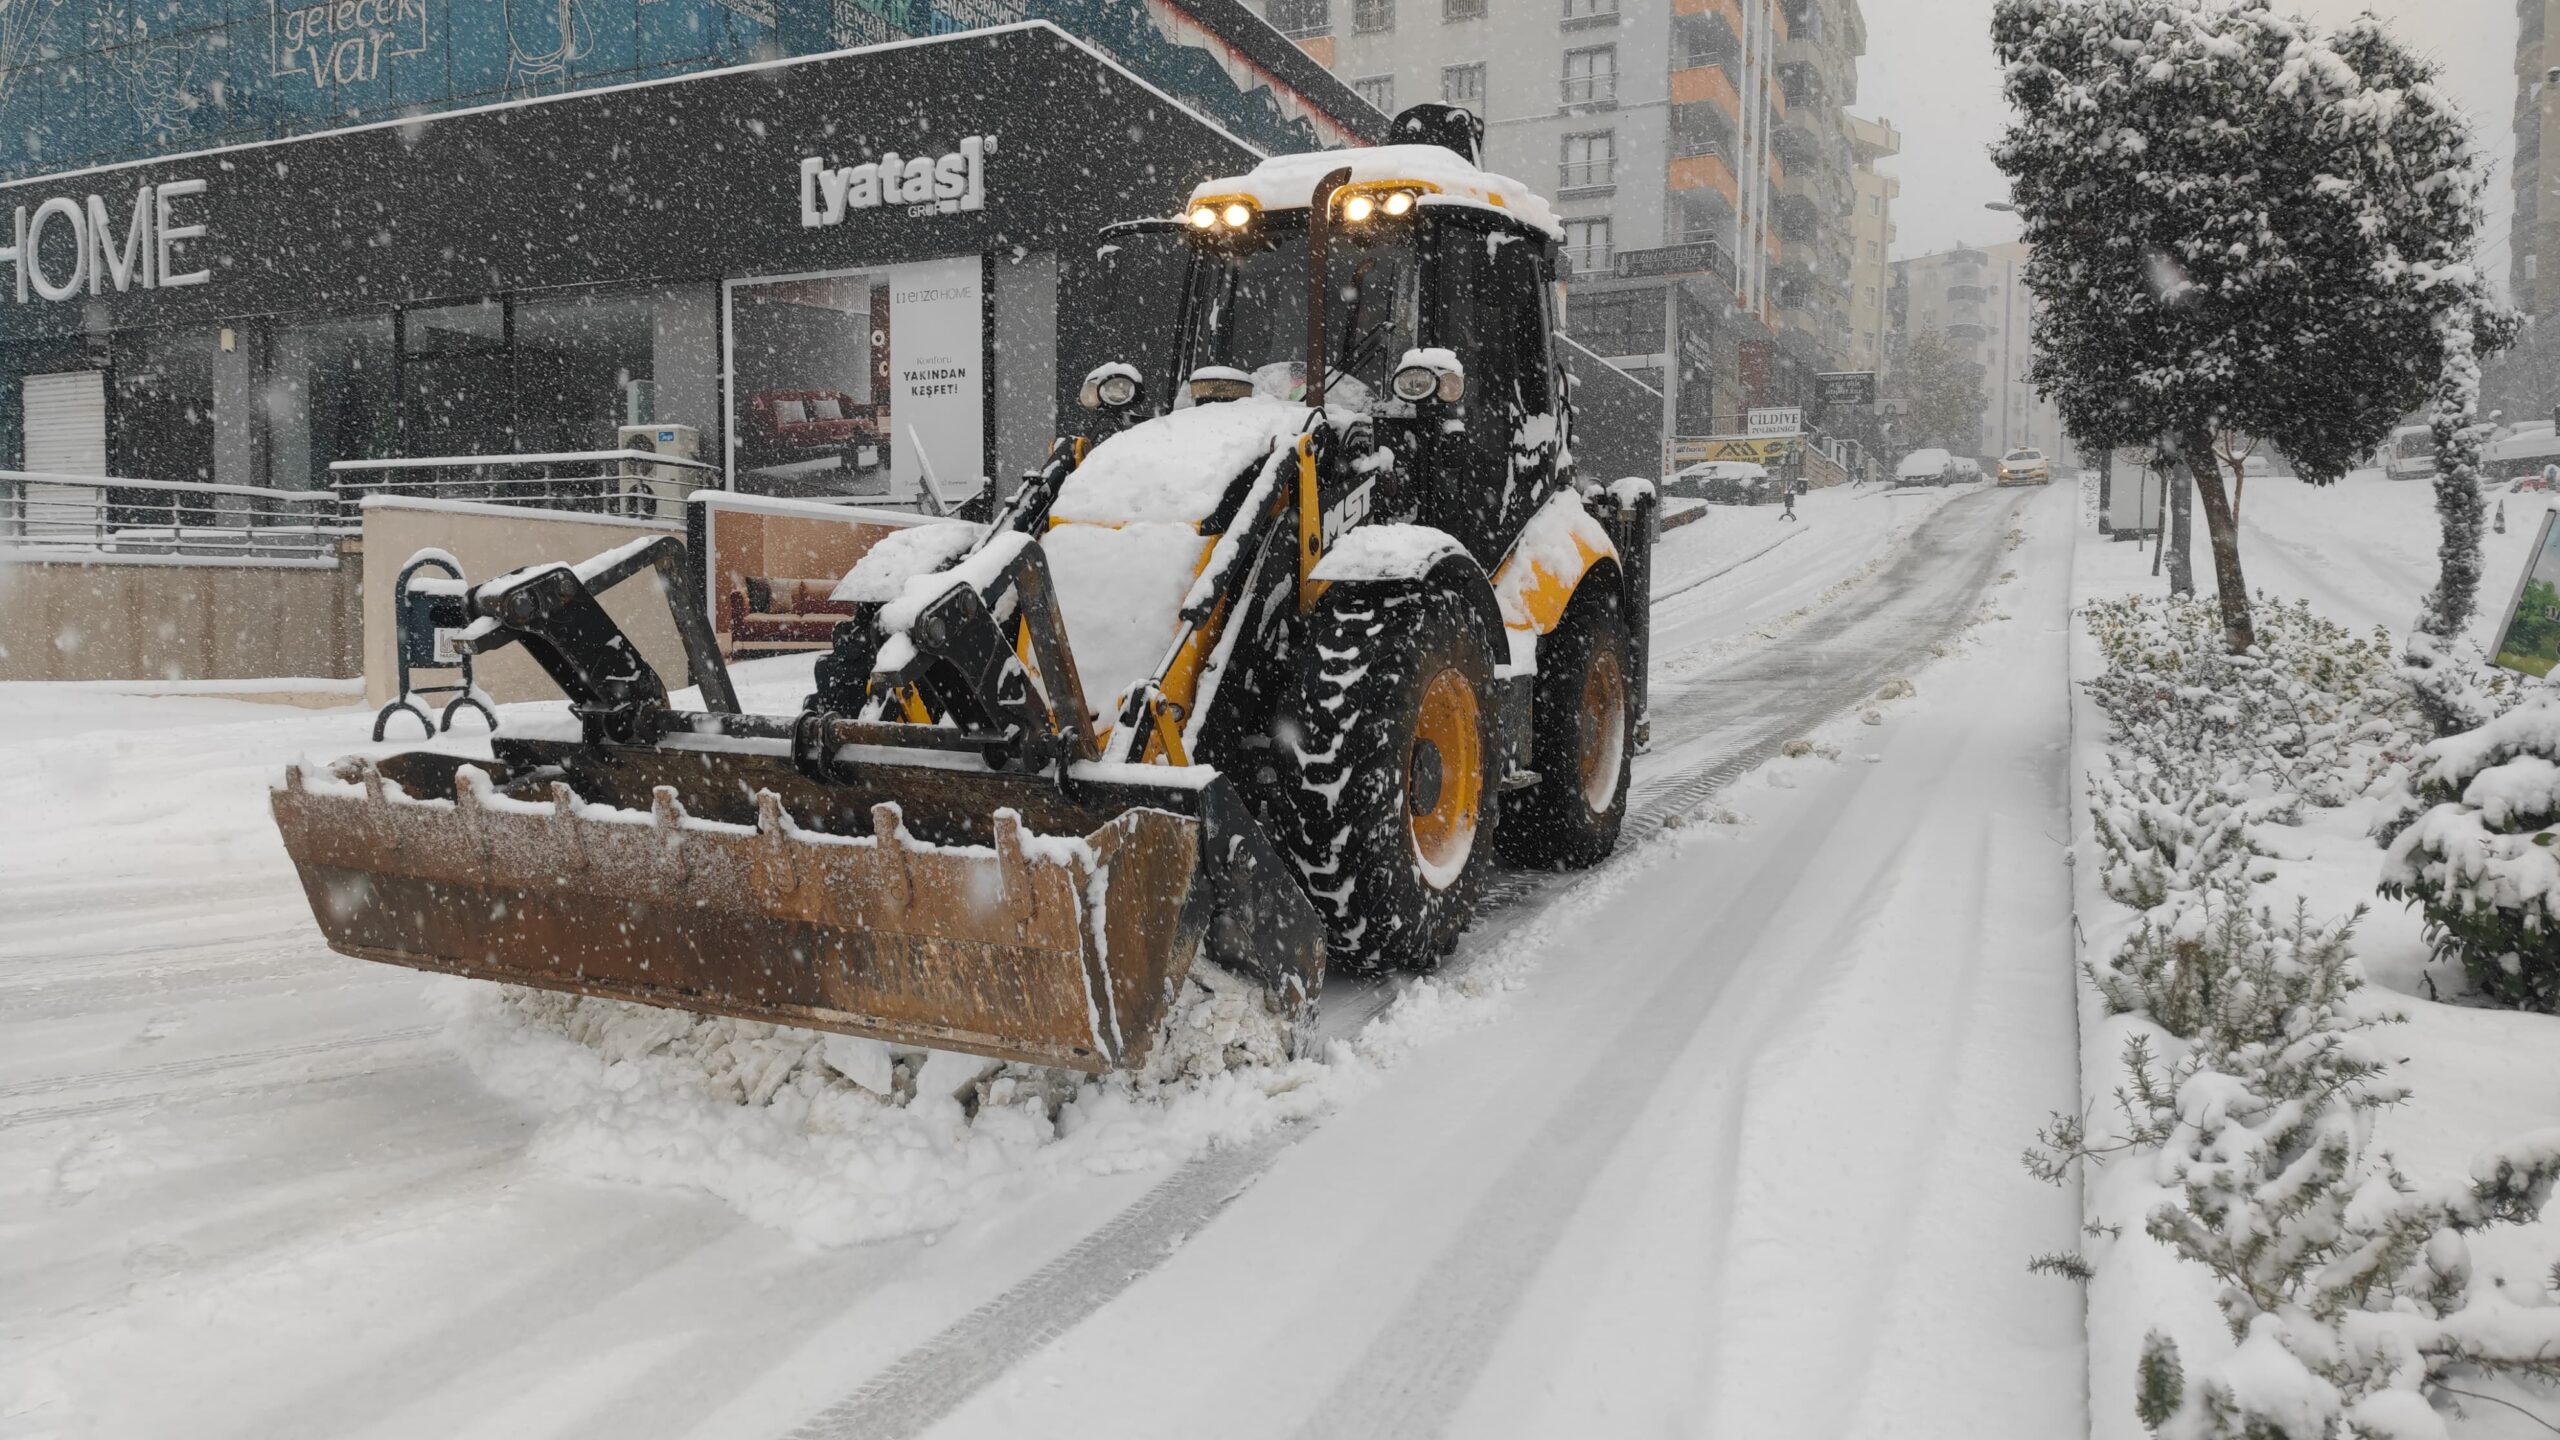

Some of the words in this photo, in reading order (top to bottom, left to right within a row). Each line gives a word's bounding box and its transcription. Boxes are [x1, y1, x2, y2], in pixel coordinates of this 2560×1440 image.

[306, 31, 395, 89] var
[903, 368, 966, 381] YAKINDAN
[911, 383, 958, 398] KEŞFET!
[1322, 471, 1377, 551] MST
